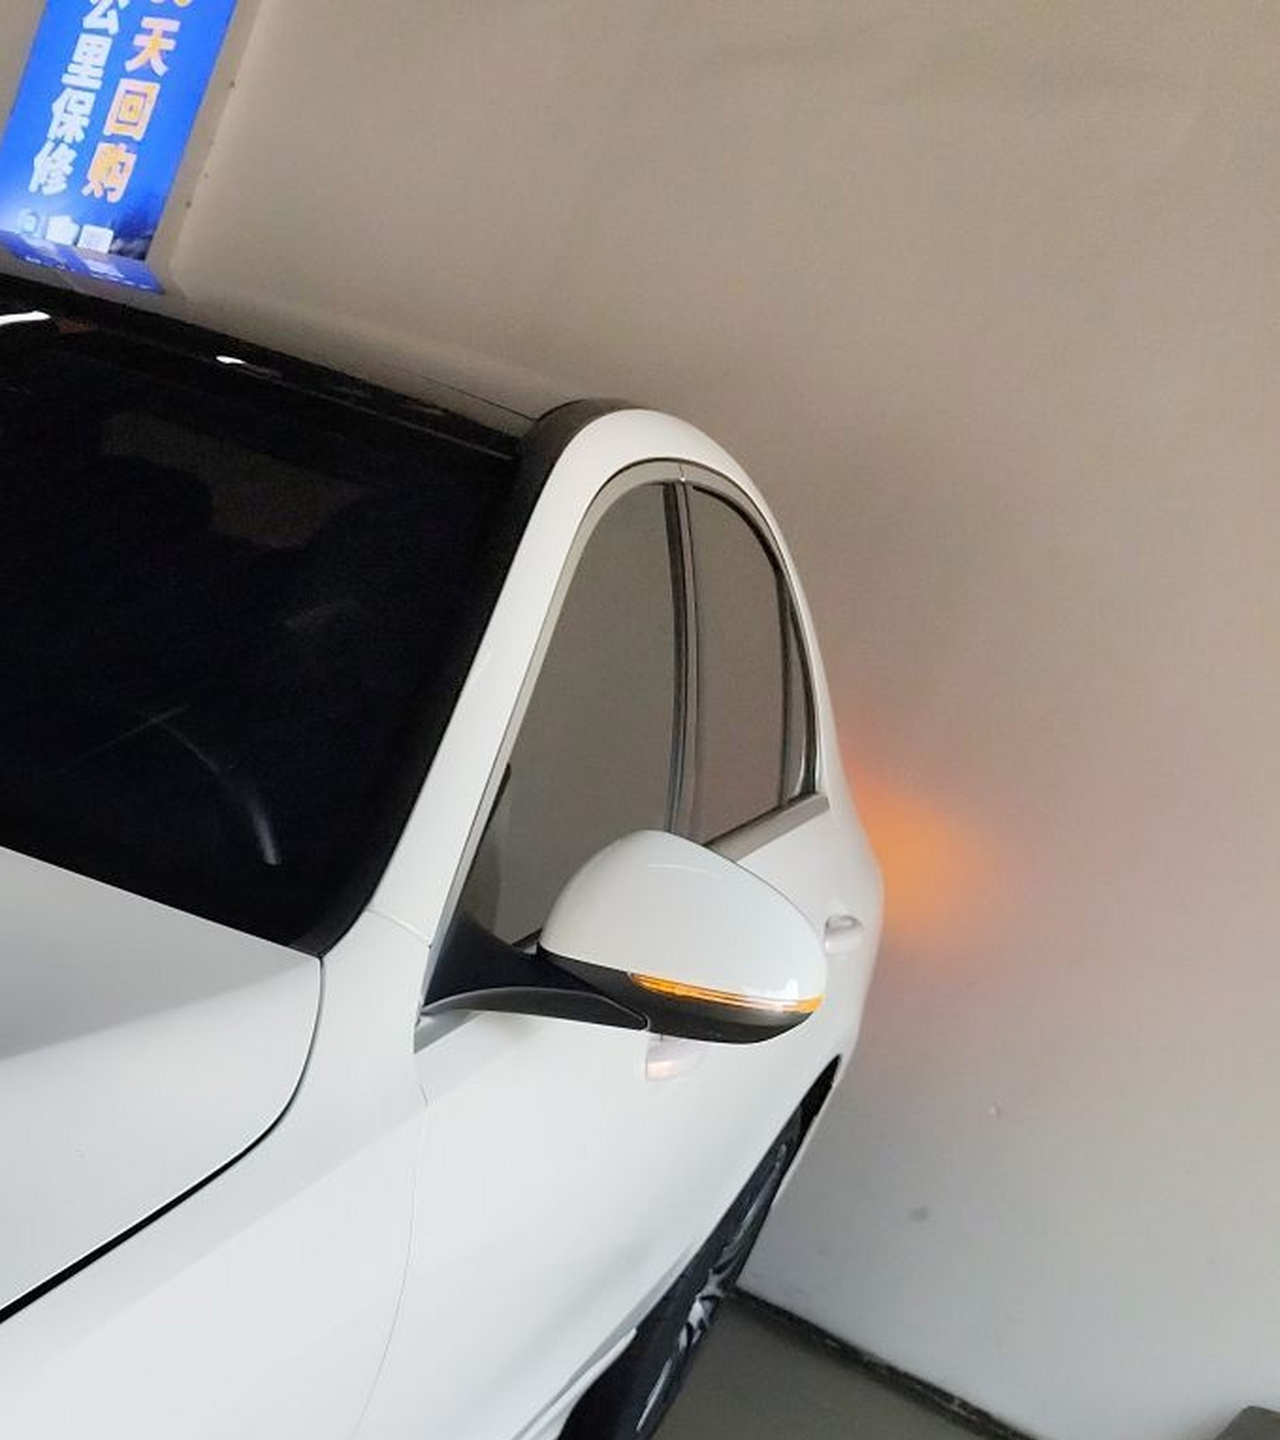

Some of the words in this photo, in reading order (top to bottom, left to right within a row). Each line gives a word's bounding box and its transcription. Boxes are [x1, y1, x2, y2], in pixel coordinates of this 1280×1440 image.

[28, 0, 128, 195] 公里保修
[82, 0, 192, 203] 天回购
